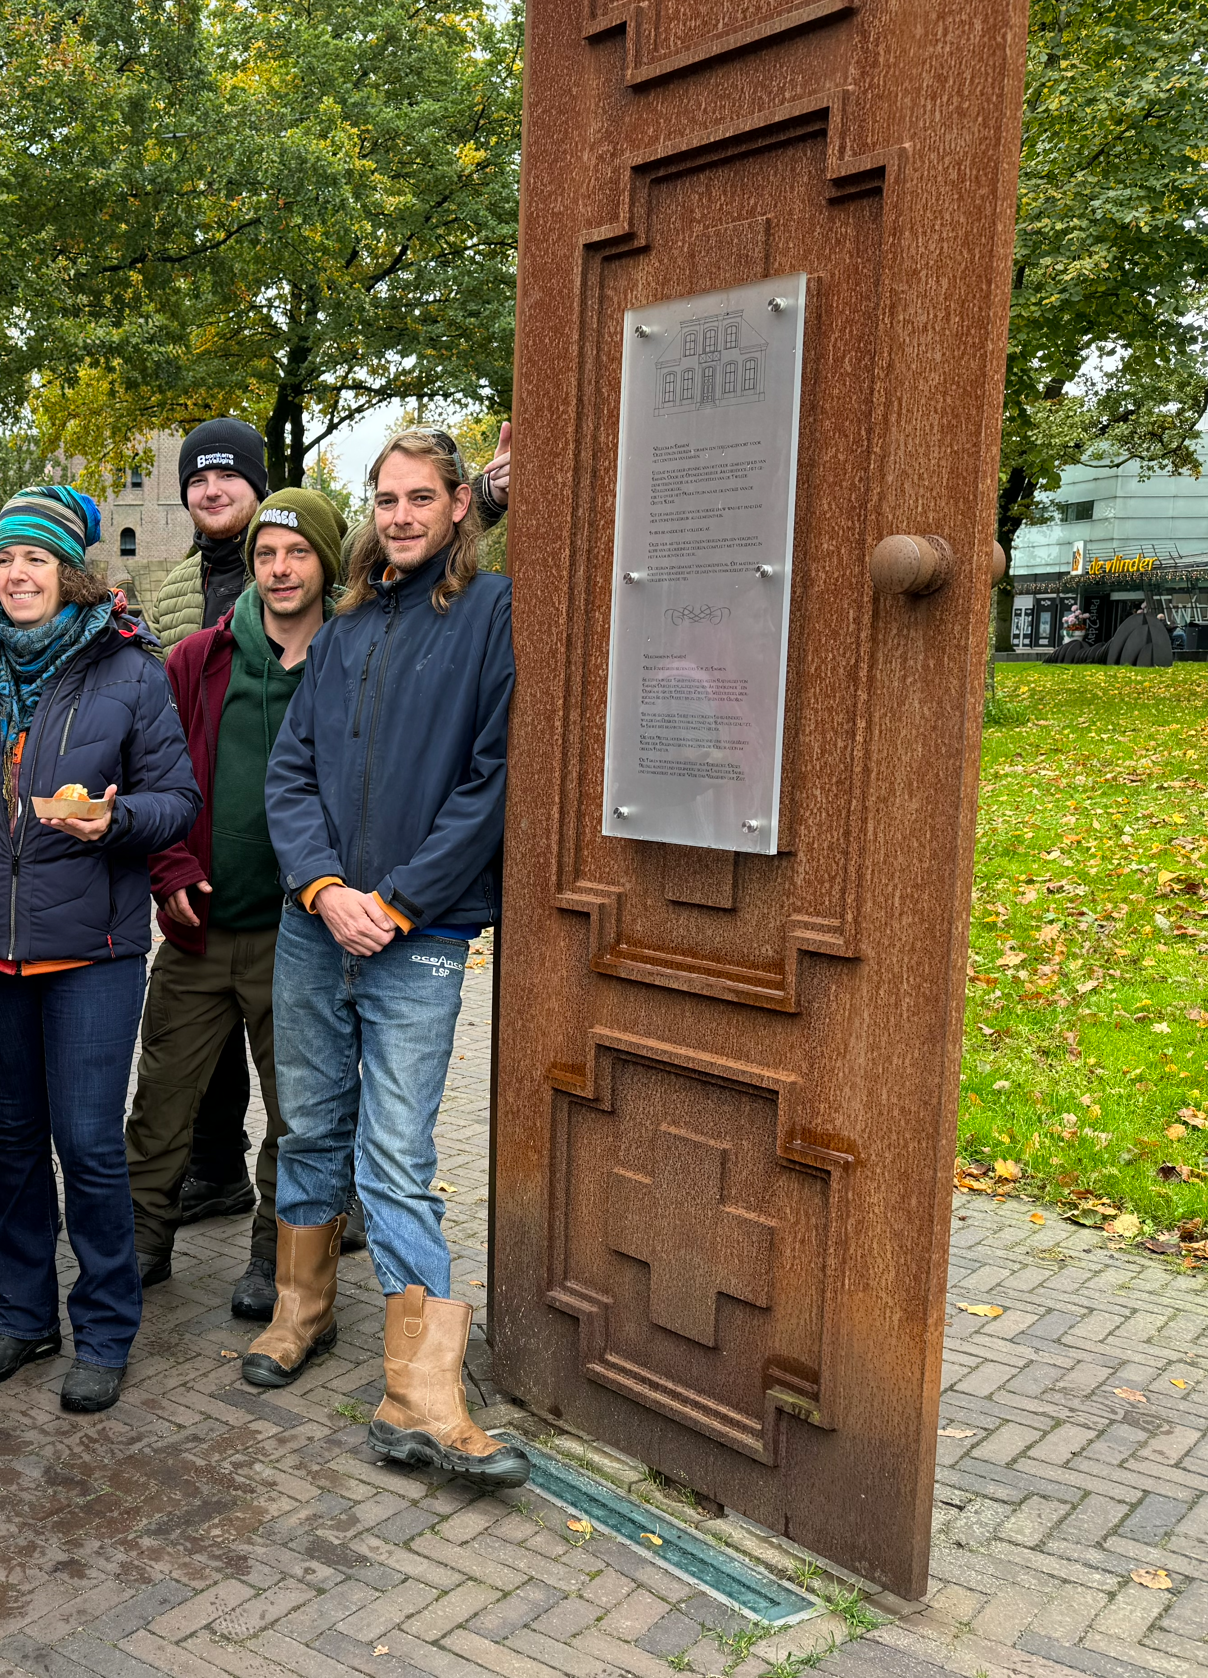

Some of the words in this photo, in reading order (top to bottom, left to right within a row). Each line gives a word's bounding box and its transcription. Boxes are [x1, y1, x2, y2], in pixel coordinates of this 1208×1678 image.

[1088, 556, 1104, 575] de
[1105, 553, 1158, 573] vlinder
[432, 967, 450, 977] LSP
